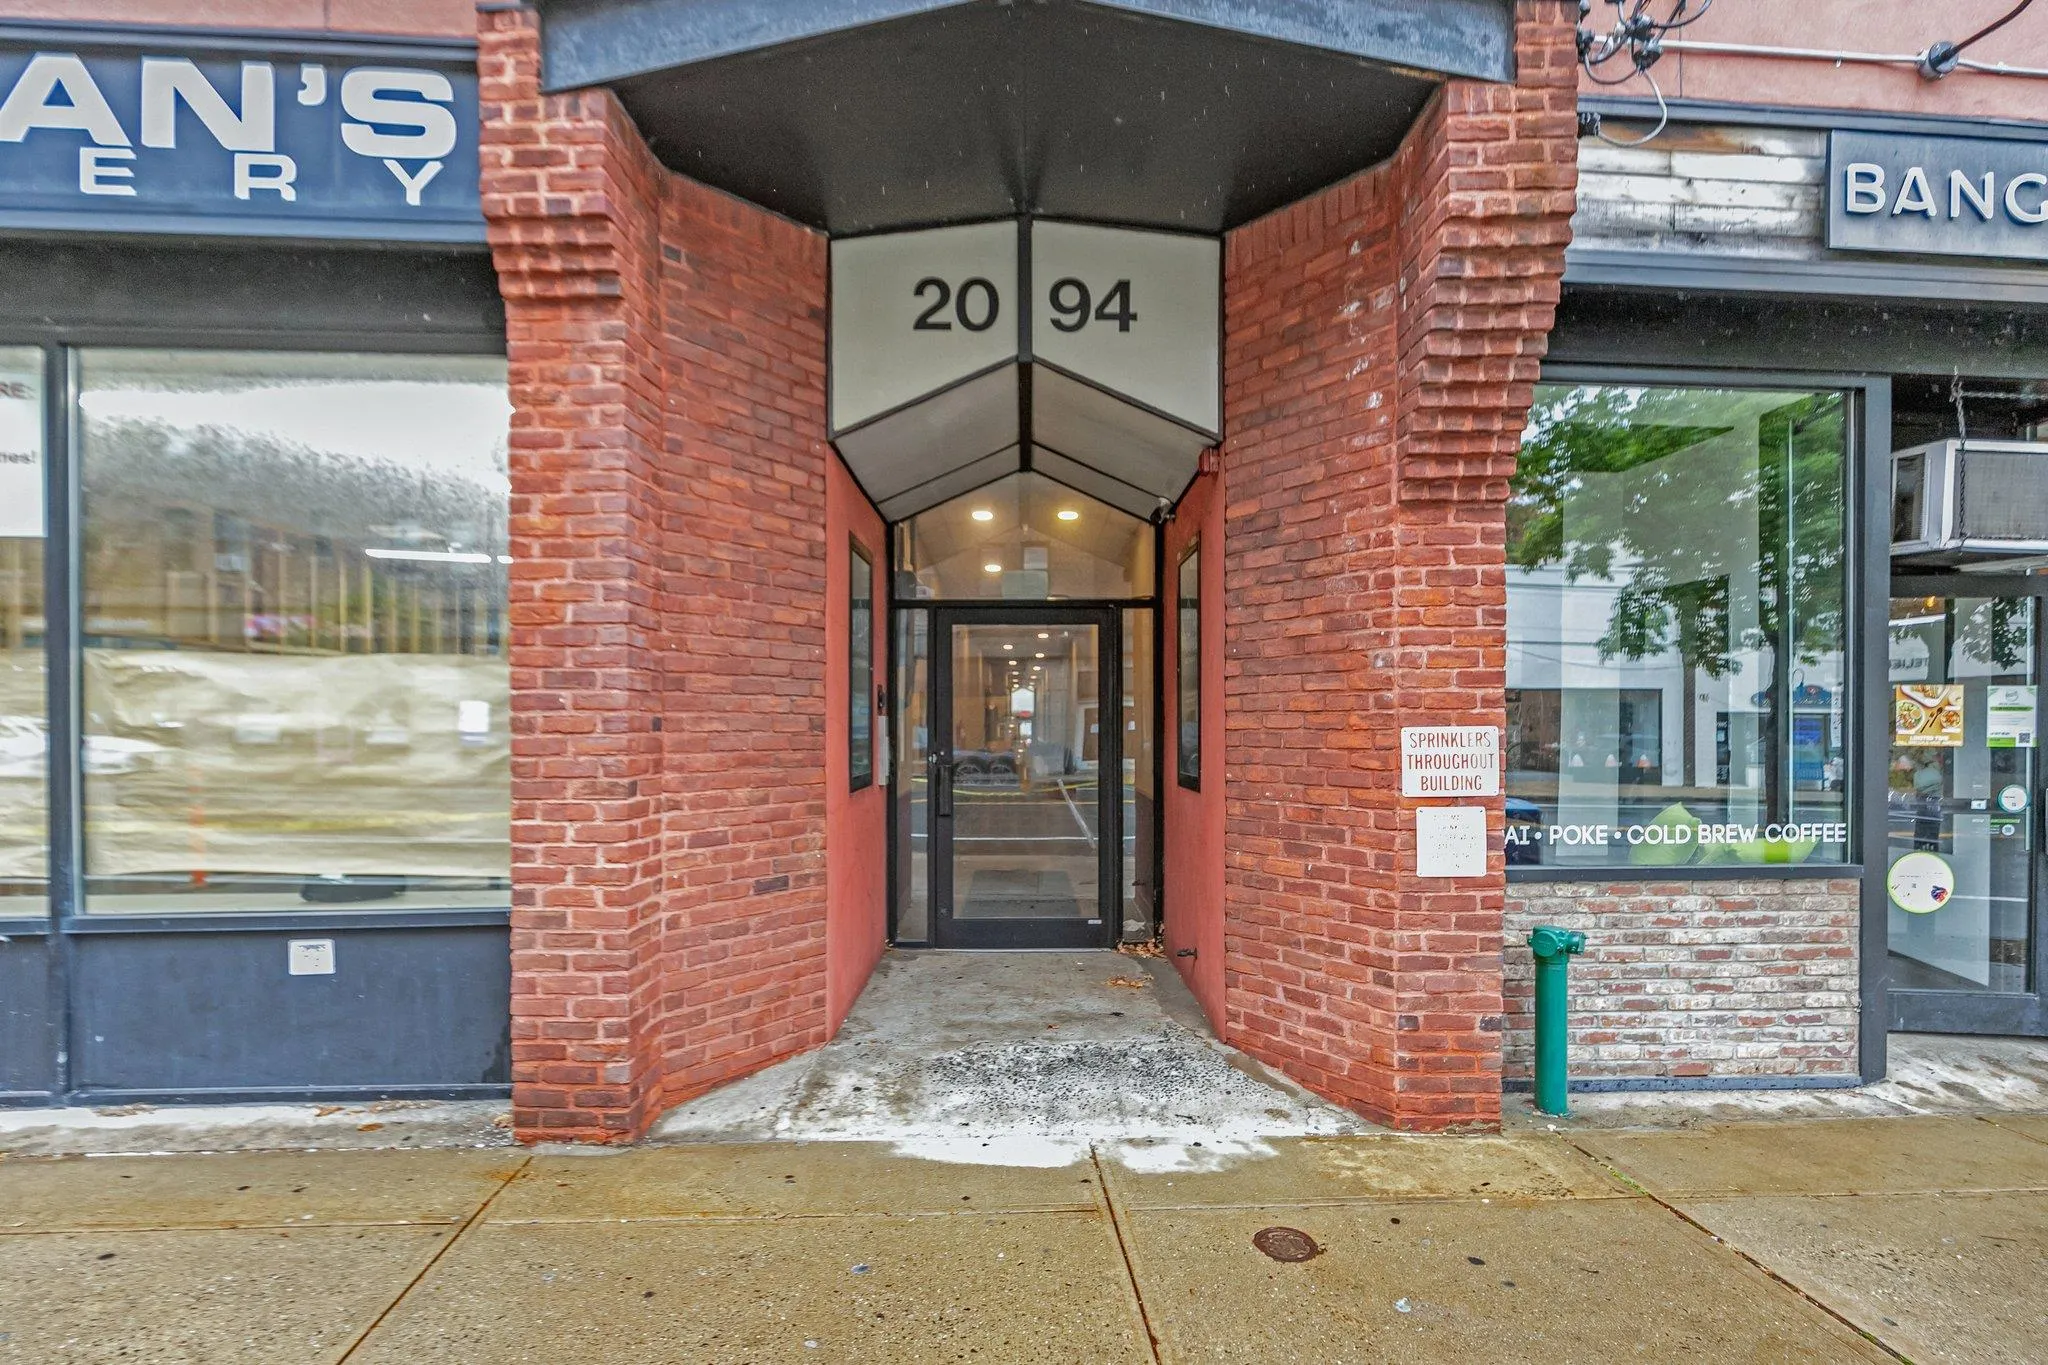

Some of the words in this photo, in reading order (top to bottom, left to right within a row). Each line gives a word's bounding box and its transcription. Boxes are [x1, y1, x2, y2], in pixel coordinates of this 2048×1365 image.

[0, 52, 457, 160] AN'S
[1846, 162, 2048, 224] BANG
[913, 276, 999, 332] 20
[1048, 276, 1138, 332] 94
[1409, 731, 1491, 749] SPRINKLERS
[1407, 752, 1494, 770] THROUGHOUT
[1420, 774, 1482, 791] BUILDING
[1549, 824, 1608, 846] POKE
[1626, 824, 1691, 846] COLD
[1697, 823, 1758, 845] BREW
[1764, 822, 1847, 844] COFFEE
